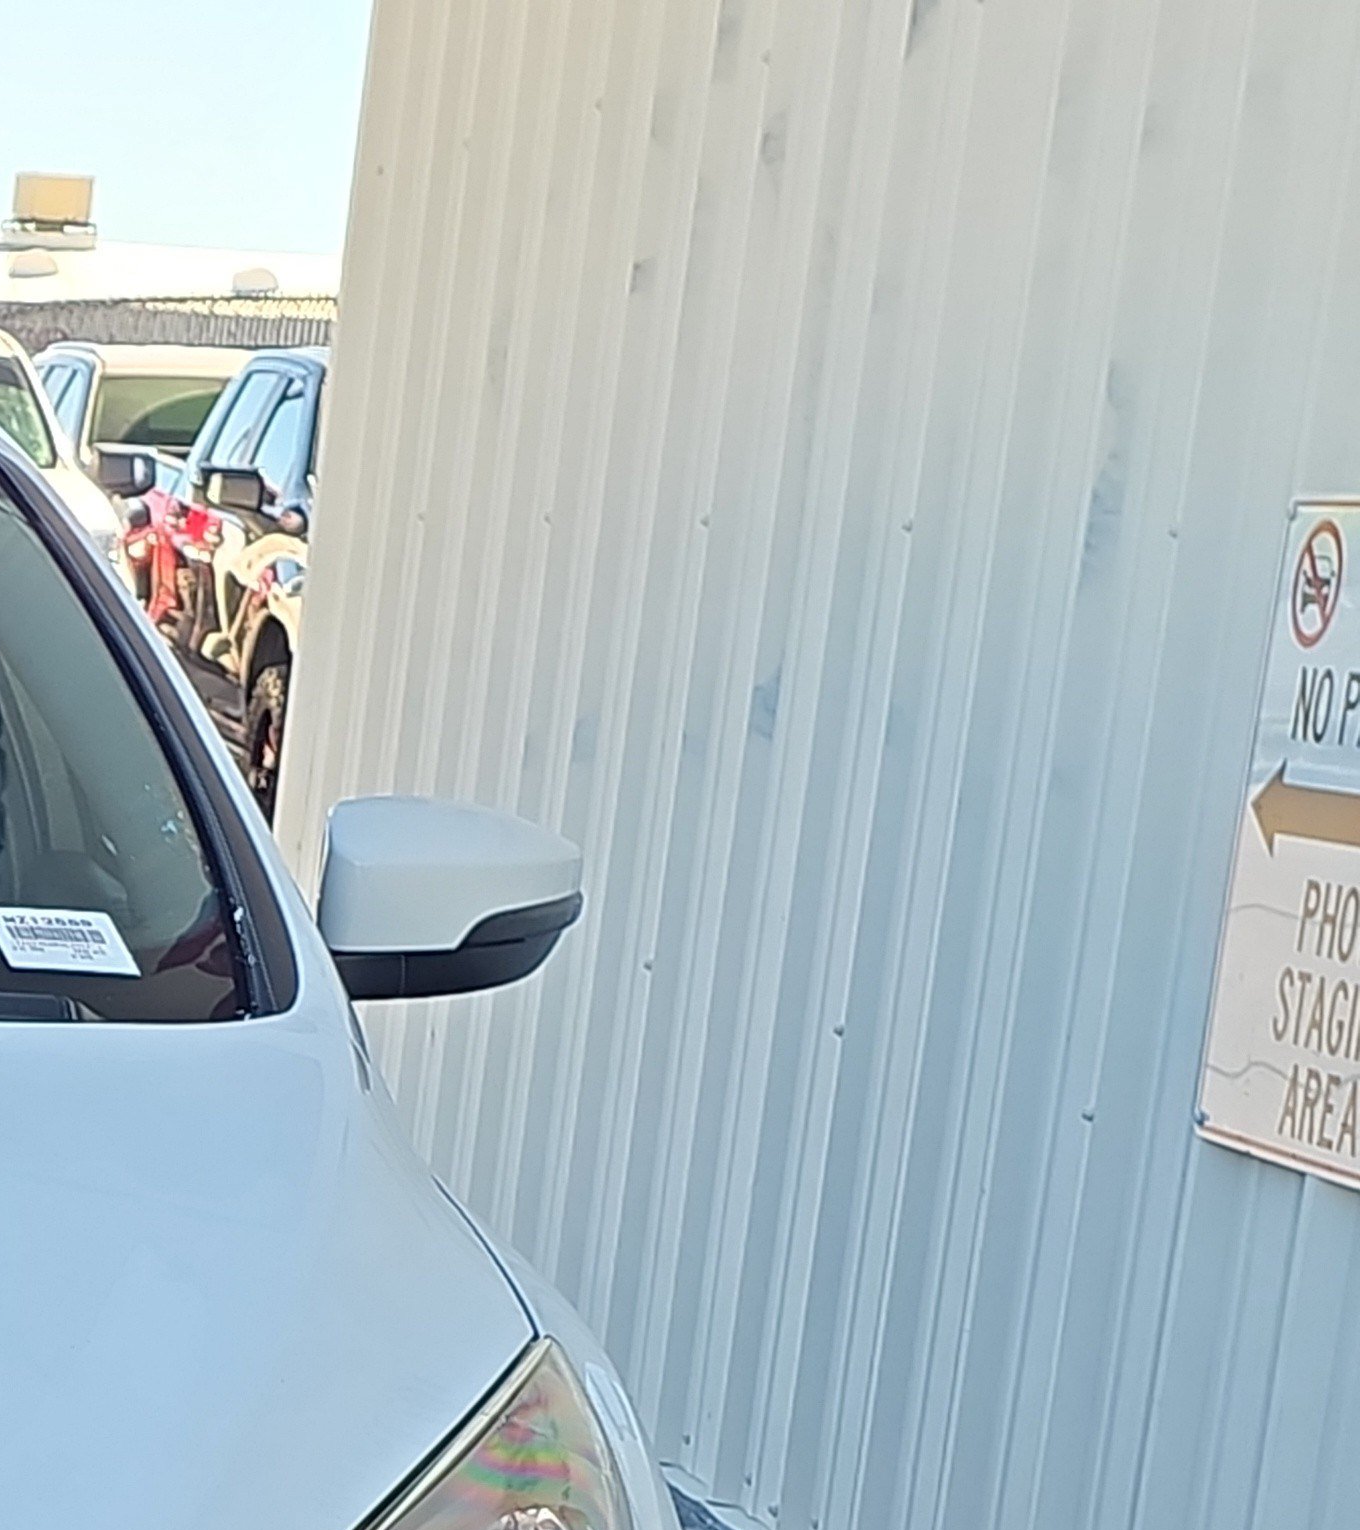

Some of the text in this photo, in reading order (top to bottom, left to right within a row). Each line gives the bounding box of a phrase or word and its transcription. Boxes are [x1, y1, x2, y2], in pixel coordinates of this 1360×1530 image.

[1290, 666, 1360, 748] NO P
[1273, 966, 1360, 1061] STAGI
[1278, 1064, 1357, 1157] AREA
